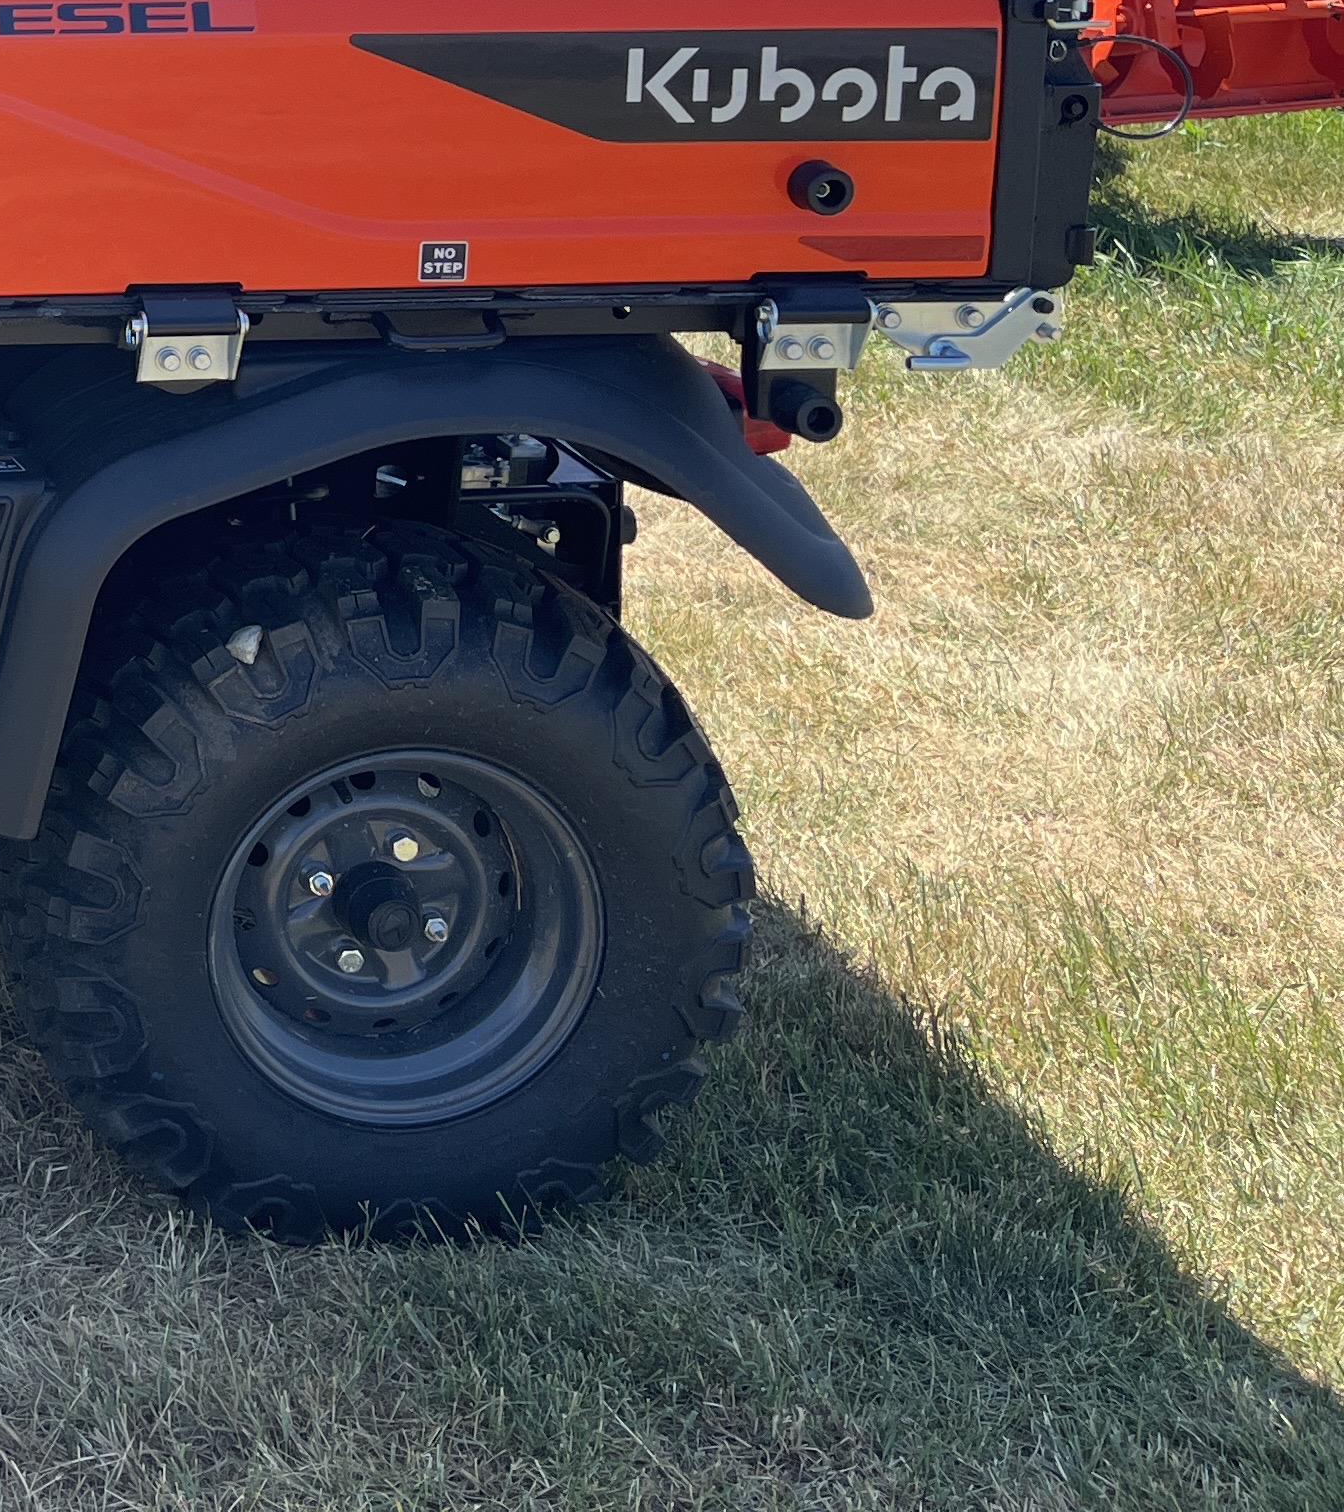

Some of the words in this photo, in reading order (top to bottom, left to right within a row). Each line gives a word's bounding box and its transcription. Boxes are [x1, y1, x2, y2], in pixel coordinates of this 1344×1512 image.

[626, 45, 976, 124] Kubota
[433, 247, 456, 259] NO
[423, 262, 463, 274] STEP
